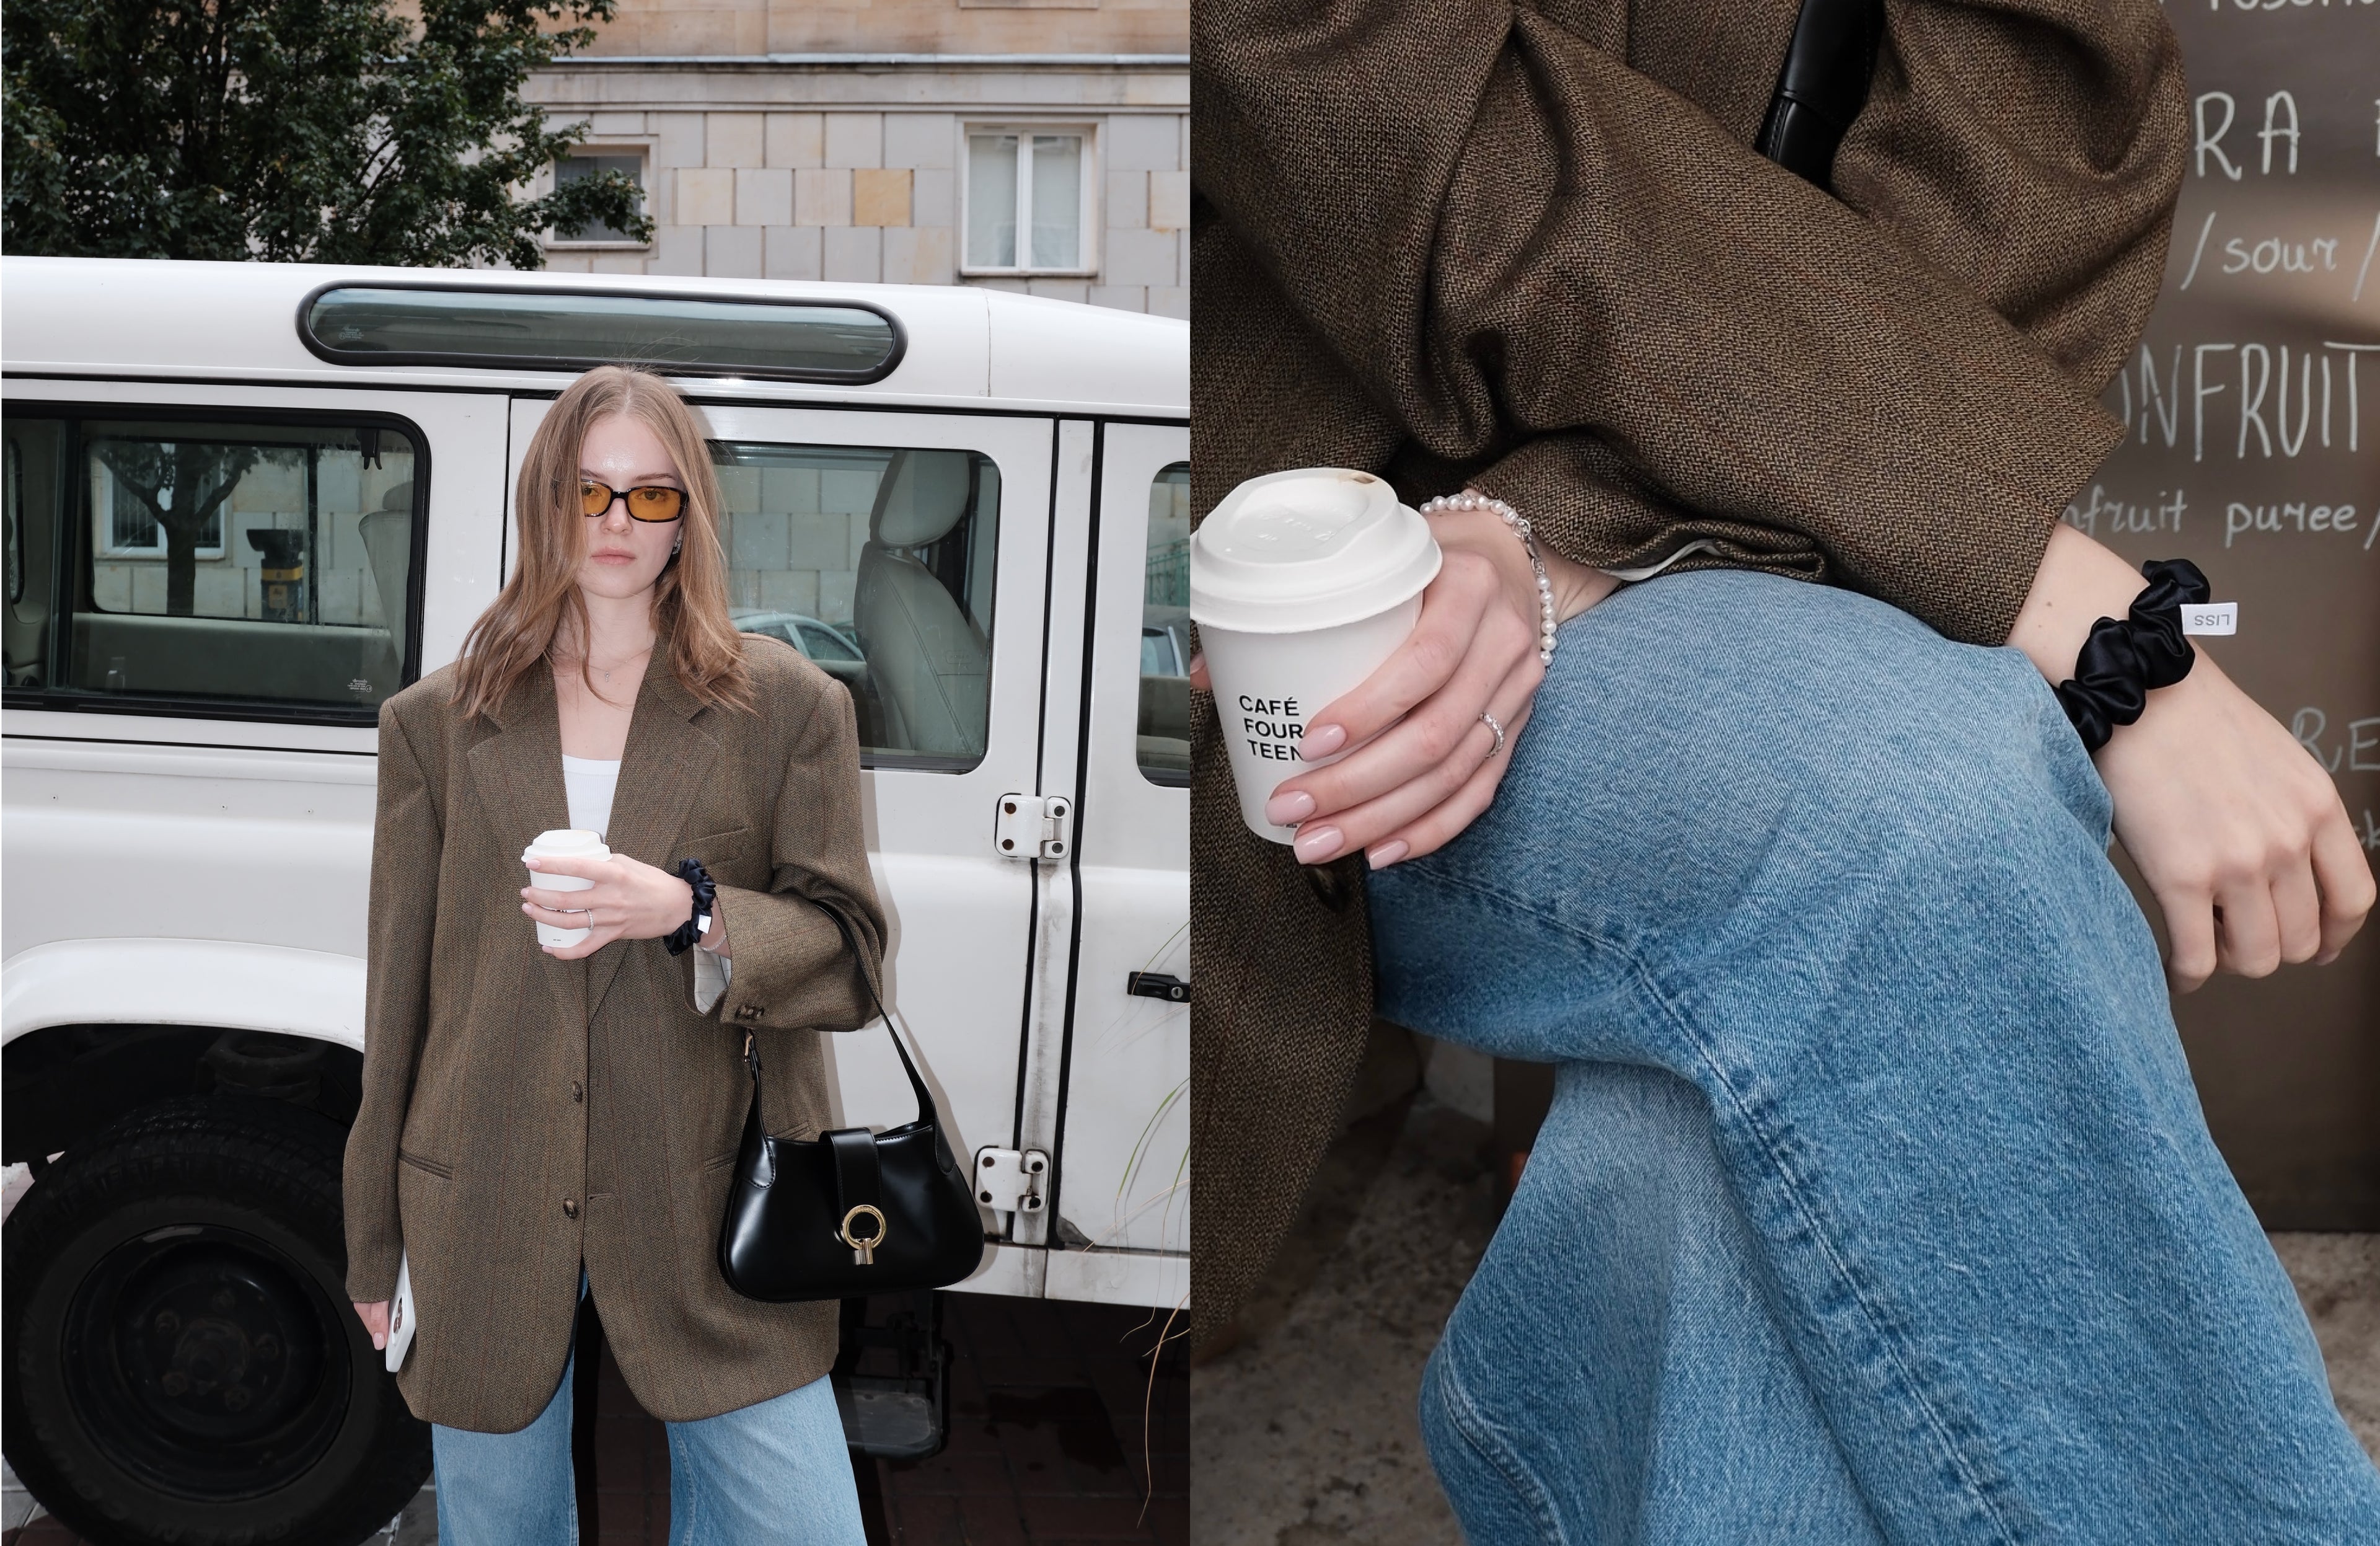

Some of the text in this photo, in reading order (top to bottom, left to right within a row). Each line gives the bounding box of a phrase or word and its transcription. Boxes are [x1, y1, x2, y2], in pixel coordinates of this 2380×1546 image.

[2194, 614, 2230, 625] LISS
[1239, 694, 1300, 716] CAFÉ
[1244, 718, 1303, 739] FOUR
